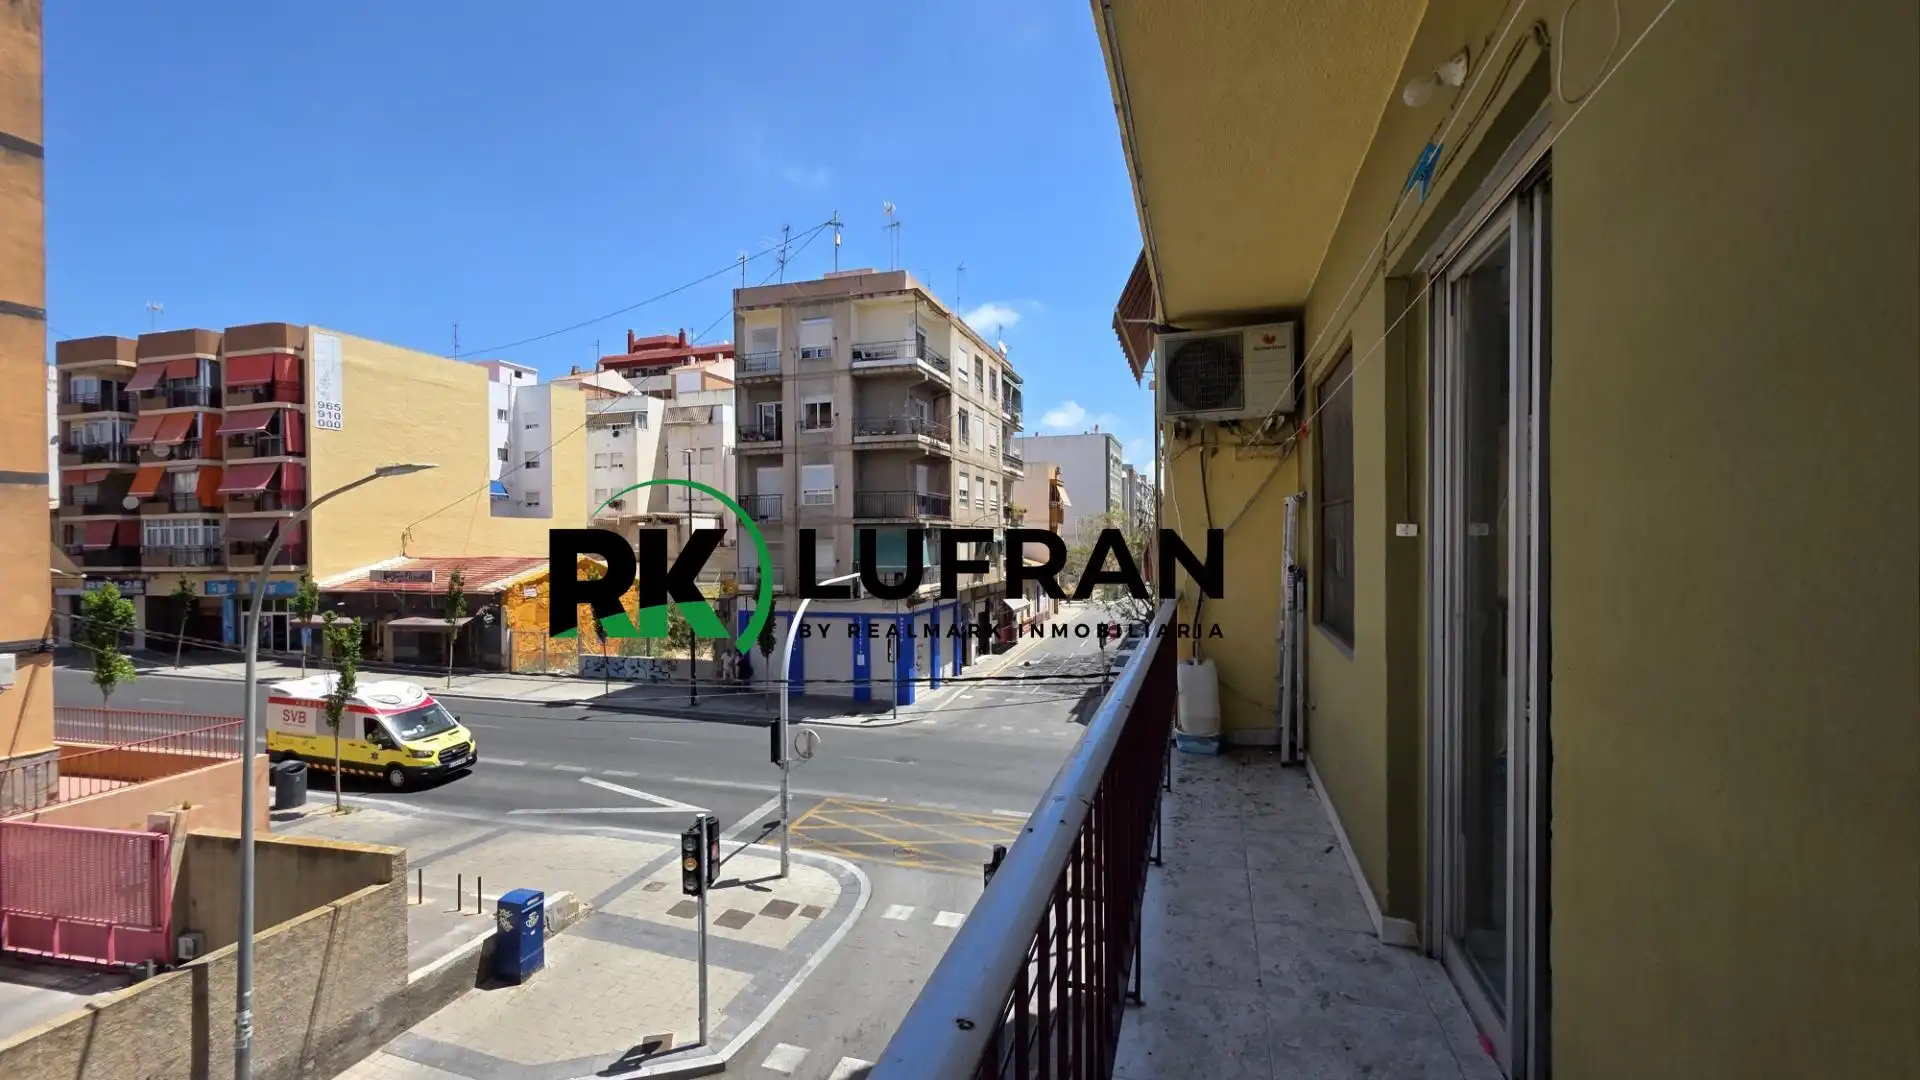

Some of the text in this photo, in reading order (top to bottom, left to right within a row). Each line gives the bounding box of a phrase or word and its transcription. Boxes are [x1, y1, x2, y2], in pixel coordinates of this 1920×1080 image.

[317, 401, 341, 411] 965
[317, 410, 341, 420] 910
[317, 419, 341, 428] 000
[282, 709, 307, 723] SVB
